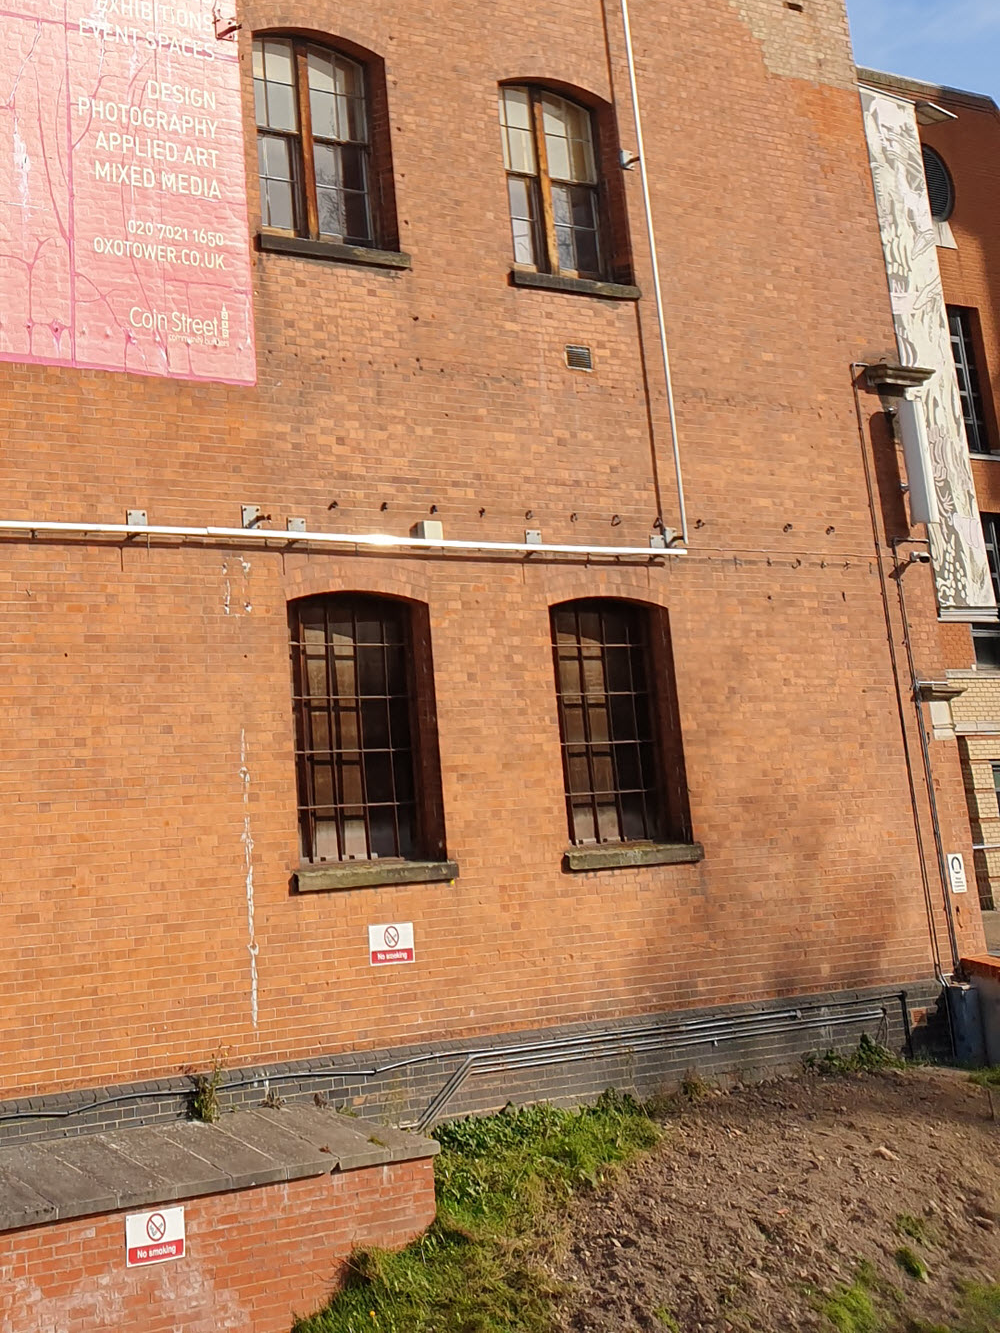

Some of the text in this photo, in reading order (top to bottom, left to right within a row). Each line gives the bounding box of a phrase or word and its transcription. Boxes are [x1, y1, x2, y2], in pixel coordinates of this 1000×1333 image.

[79, 17, 215, 62] EVENT SPACES
[147, 79, 217, 110] DESIGN
[78, 96, 218, 139] PHOTOGRAPHY
[95, 130, 219, 169] APPLIED ART
[94, 160, 222, 199] MIXED MEDIA
[128, 219, 224, 248] 020 7021 1650
[93, 236, 226, 270] OXOTOWER.CO.UK
[129, 306, 168, 330] Coin
[171, 311, 219, 337] Street
[377, 952, 386, 960] No
[136, 1244, 177, 1260] No smoking
